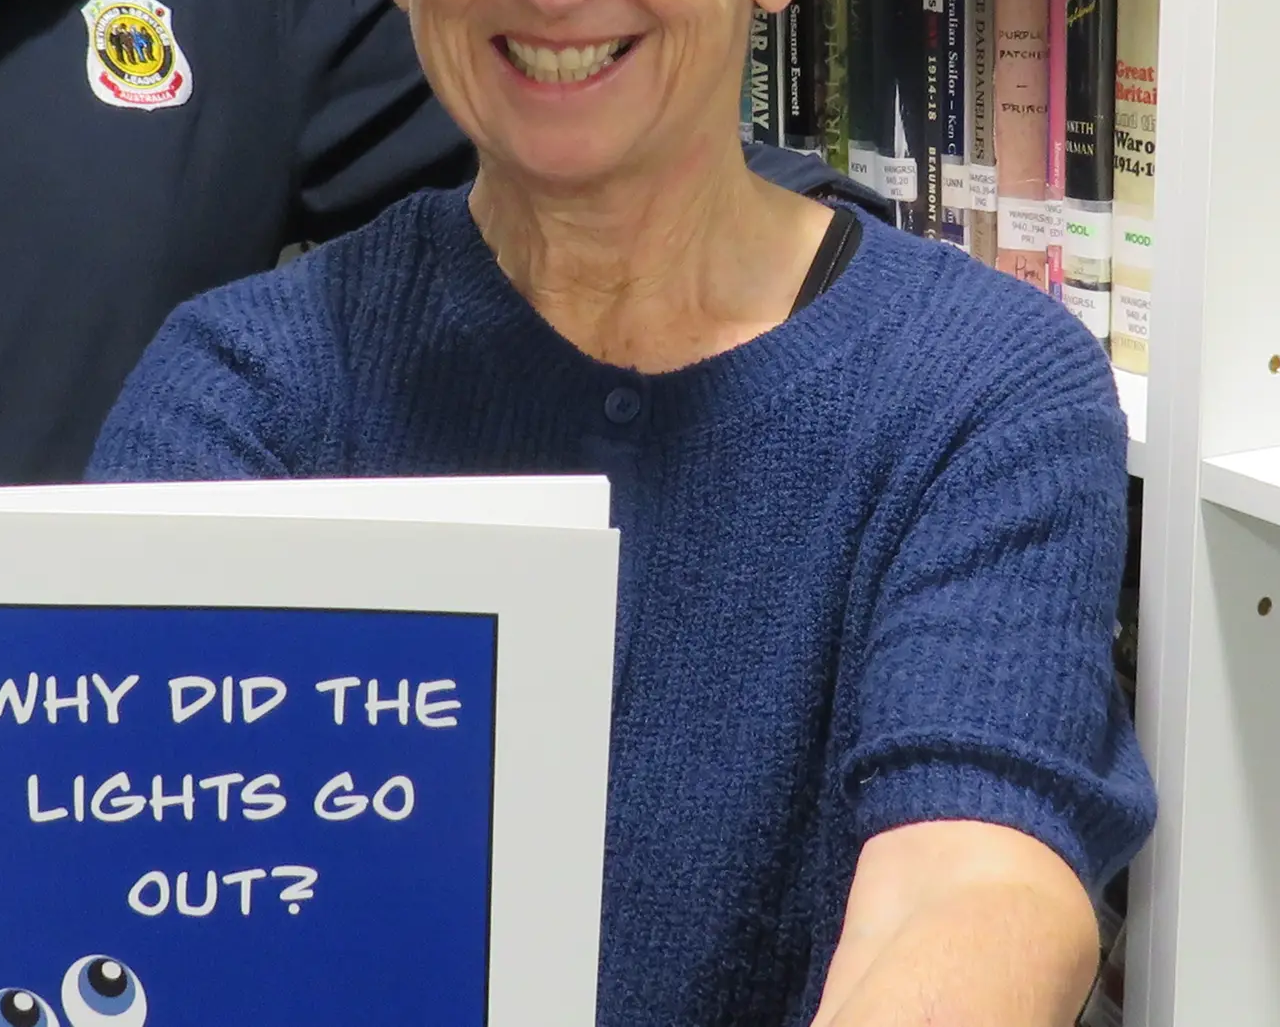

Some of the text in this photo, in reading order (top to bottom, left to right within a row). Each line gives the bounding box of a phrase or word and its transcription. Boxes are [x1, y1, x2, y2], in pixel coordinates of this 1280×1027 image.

[123, 72, 162, 86] LEAGUE
[790, 4, 802, 117] Susanne Everett
[948, 49, 959, 97] Sailor
[121, 89, 173, 104] AUSTRALIA
[751, 59, 770, 130] AWAY
[927, 54, 938, 121] 1914-18
[974, 19, 986, 160] DARDANELLES
[948, 114, 957, 140] Ken
[1114, 130, 1144, 150] War
[927, 146, 938, 223] BEAUMONT
[169, 675, 287, 725] DID
[315, 677, 462, 729] THE
[27, 771, 415, 824] LIGHTS GO
[128, 865, 319, 918] OUT?
